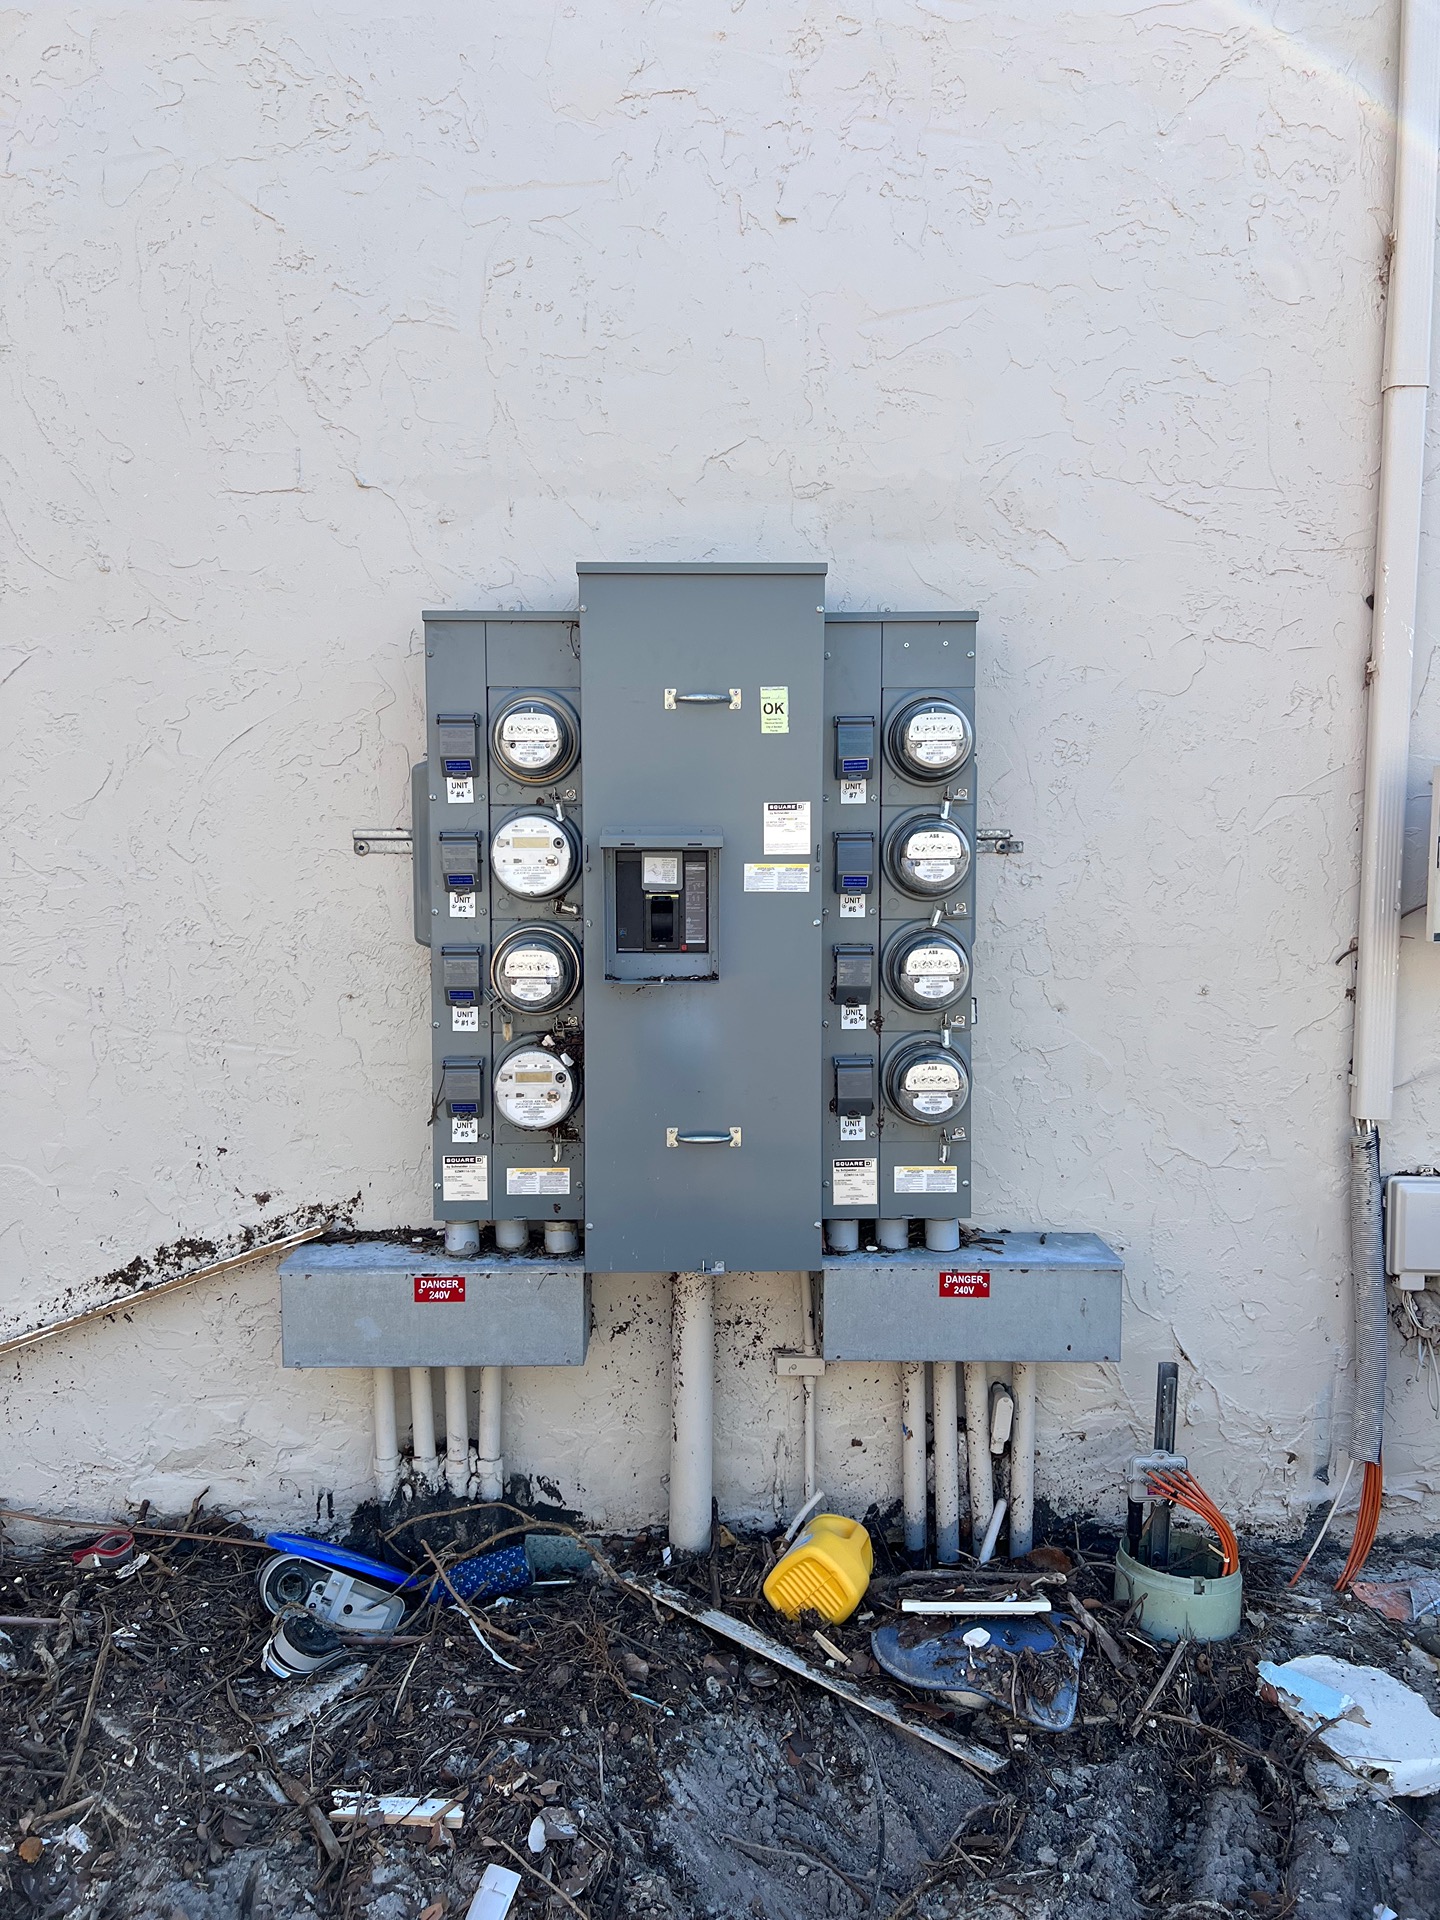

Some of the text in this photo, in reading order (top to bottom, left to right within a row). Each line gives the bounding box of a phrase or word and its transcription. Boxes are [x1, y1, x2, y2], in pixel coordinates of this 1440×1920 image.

[763, 702, 784, 715] OK
[454, 896, 471, 904] UNIT
[458, 905, 467, 913] #2
[849, 1017, 858, 1025] #8
[946, 1275, 983, 1284] DANGER
[420, 1280, 459, 1288] DANGER
[953, 1286, 974, 1294] 240V
[429, 1290, 450, 1299] 240V
